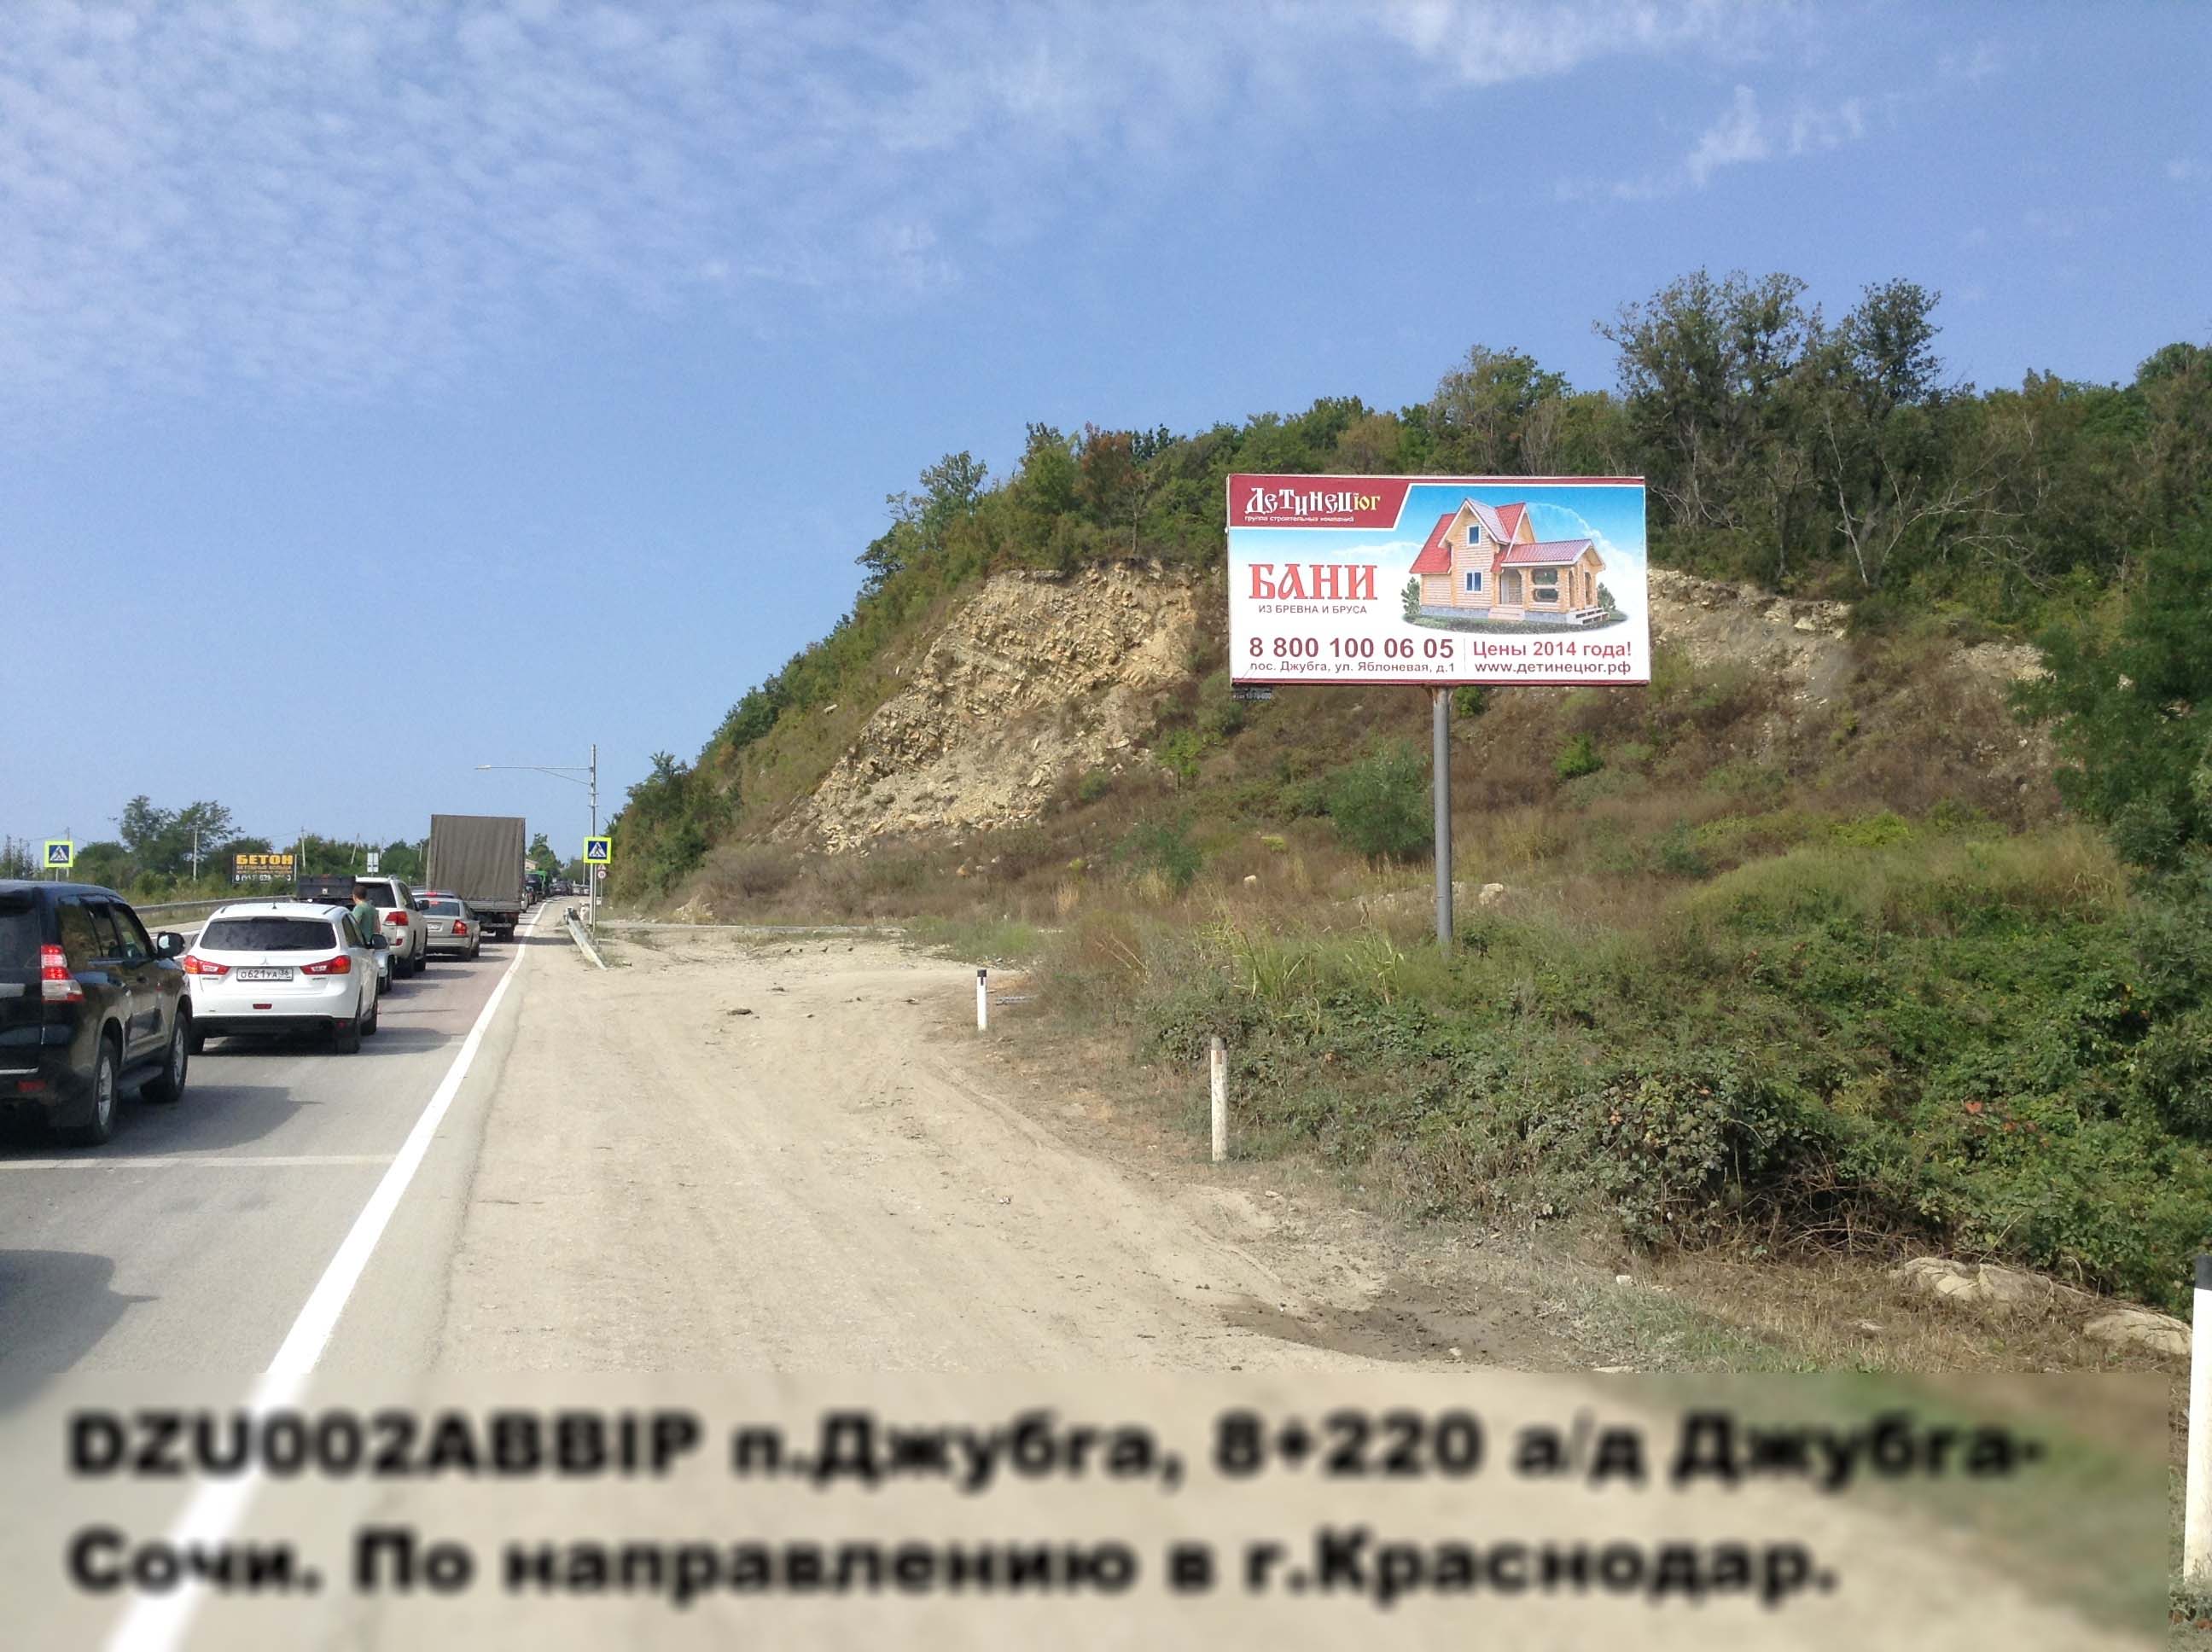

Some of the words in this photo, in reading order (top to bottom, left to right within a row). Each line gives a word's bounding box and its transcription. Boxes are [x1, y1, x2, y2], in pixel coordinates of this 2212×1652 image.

[1248, 563, 1378, 601] БАНИ
[1258, 604, 1272, 614] ИЗ
[1275, 604, 1319, 614] БРЕВНА
[1322, 605, 1330, 614] И
[1332, 605, 1367, 614] БРУСА
[1249, 637, 1264, 658] 8
[1272, 637, 1319, 658] 800
[1329, 638, 1374, 659] 100
[1383, 638, 1414, 659] 06
[1423, 638, 1454, 659] 05
[1473, 641, 1527, 659] Цены
[1533, 641, 1577, 656] 2014
[1583, 642, 1632, 659] года!
[1249, 662, 1276, 671] пос.
[1280, 660, 1331, 673] Джубга,
[1335, 663, 1353, 673] ул.
[1358, 662, 1432, 673] Яблоневая,
[1436, 663, 1454, 674] д.1
[1474, 660, 1632, 676] www.детинецюг.рф
[236, 854, 294, 865] БЕТОН
